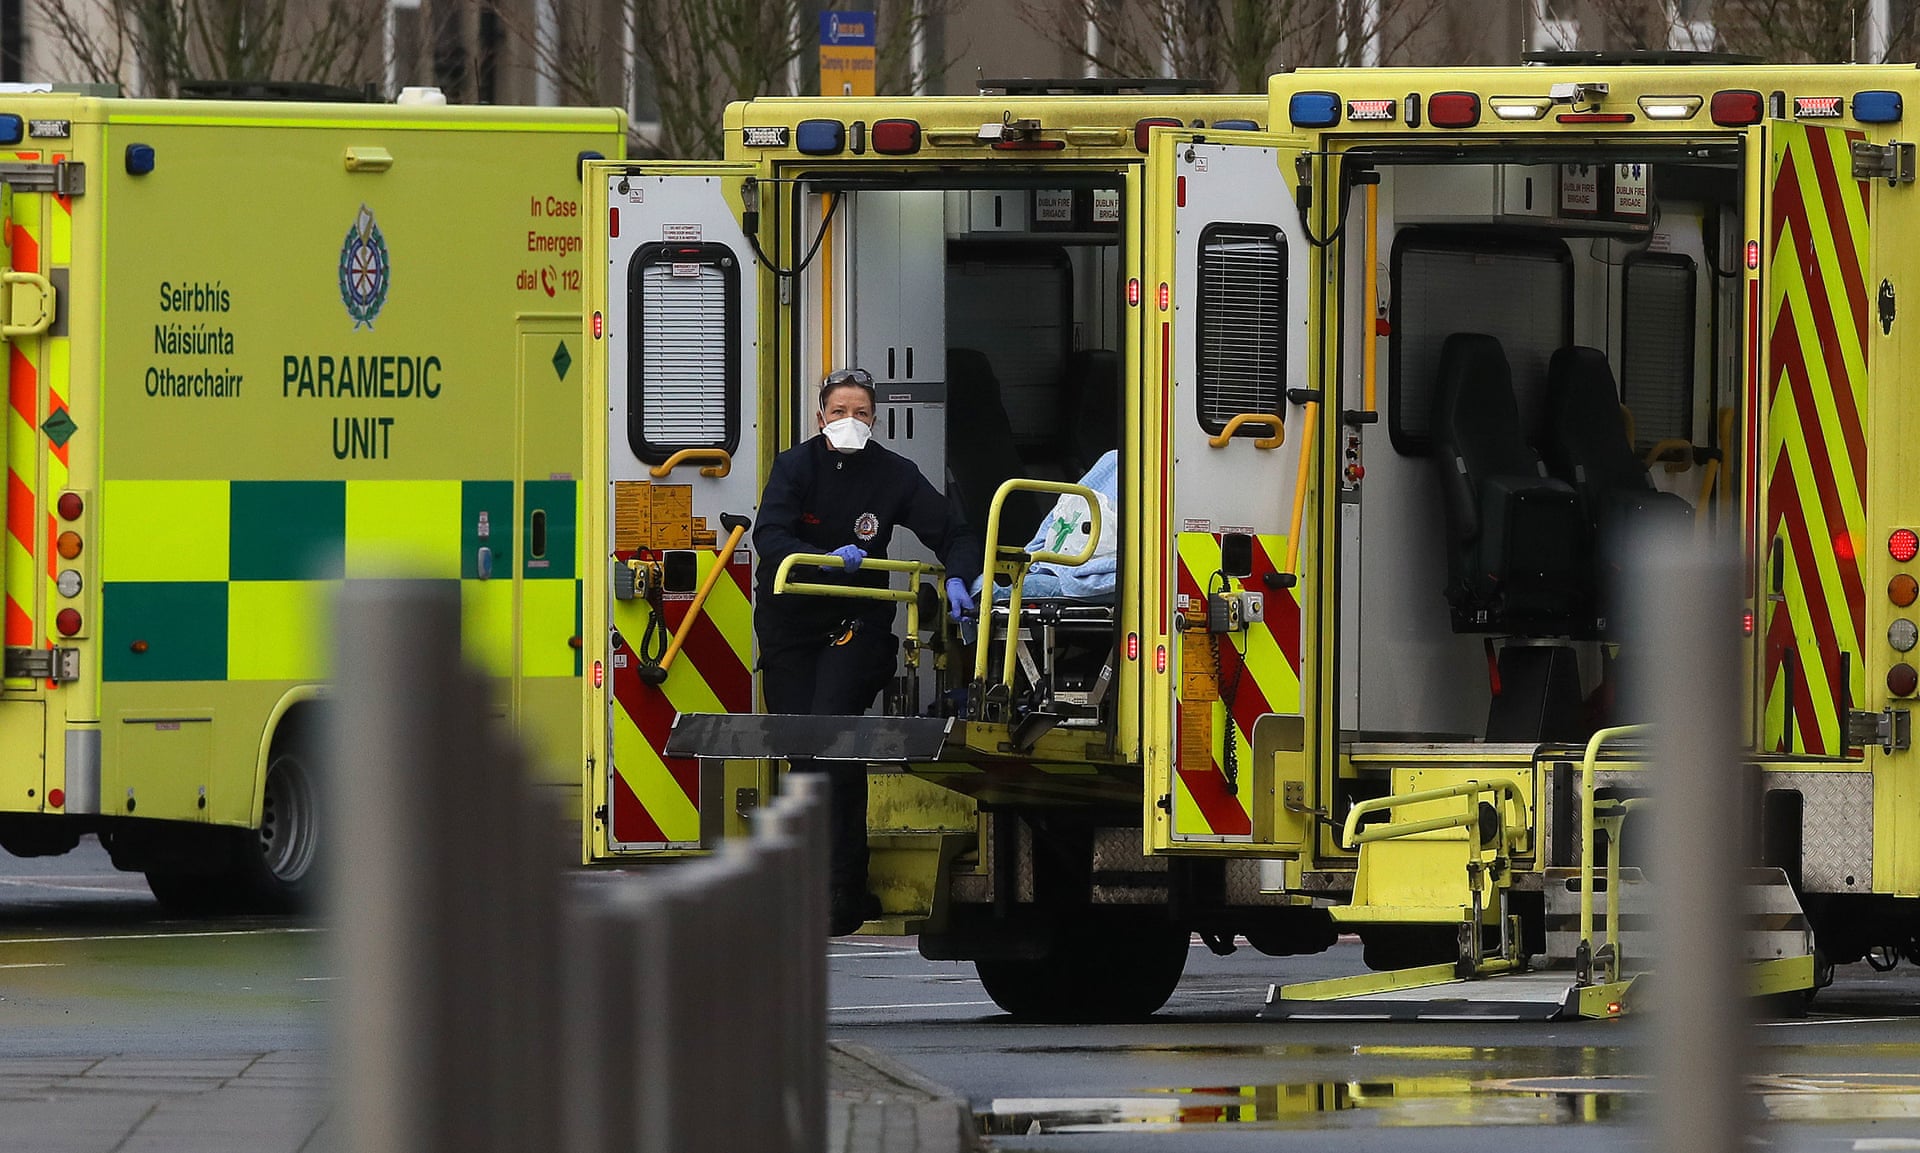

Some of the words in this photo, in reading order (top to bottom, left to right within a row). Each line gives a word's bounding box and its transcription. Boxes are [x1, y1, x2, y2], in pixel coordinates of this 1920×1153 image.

[1581, 183, 1595, 193] FIRE
[1615, 186, 1633, 195] DUBLIN
[1634, 187, 1646, 196] FIRE
[531, 195, 542, 216] In
[546, 196, 577, 217] Case
[1095, 199, 1114, 208] DUBLIN
[1620, 198, 1641, 207] BRIGADE
[516, 269, 537, 290] dial
[160, 281, 230, 312] Seirbhís
[154, 323, 234, 355] Náisiúnta
[145, 366, 243, 397] Otharchairr
[283, 355, 442, 399] PARAMEDIC
[332, 417, 395, 460] UNIT
